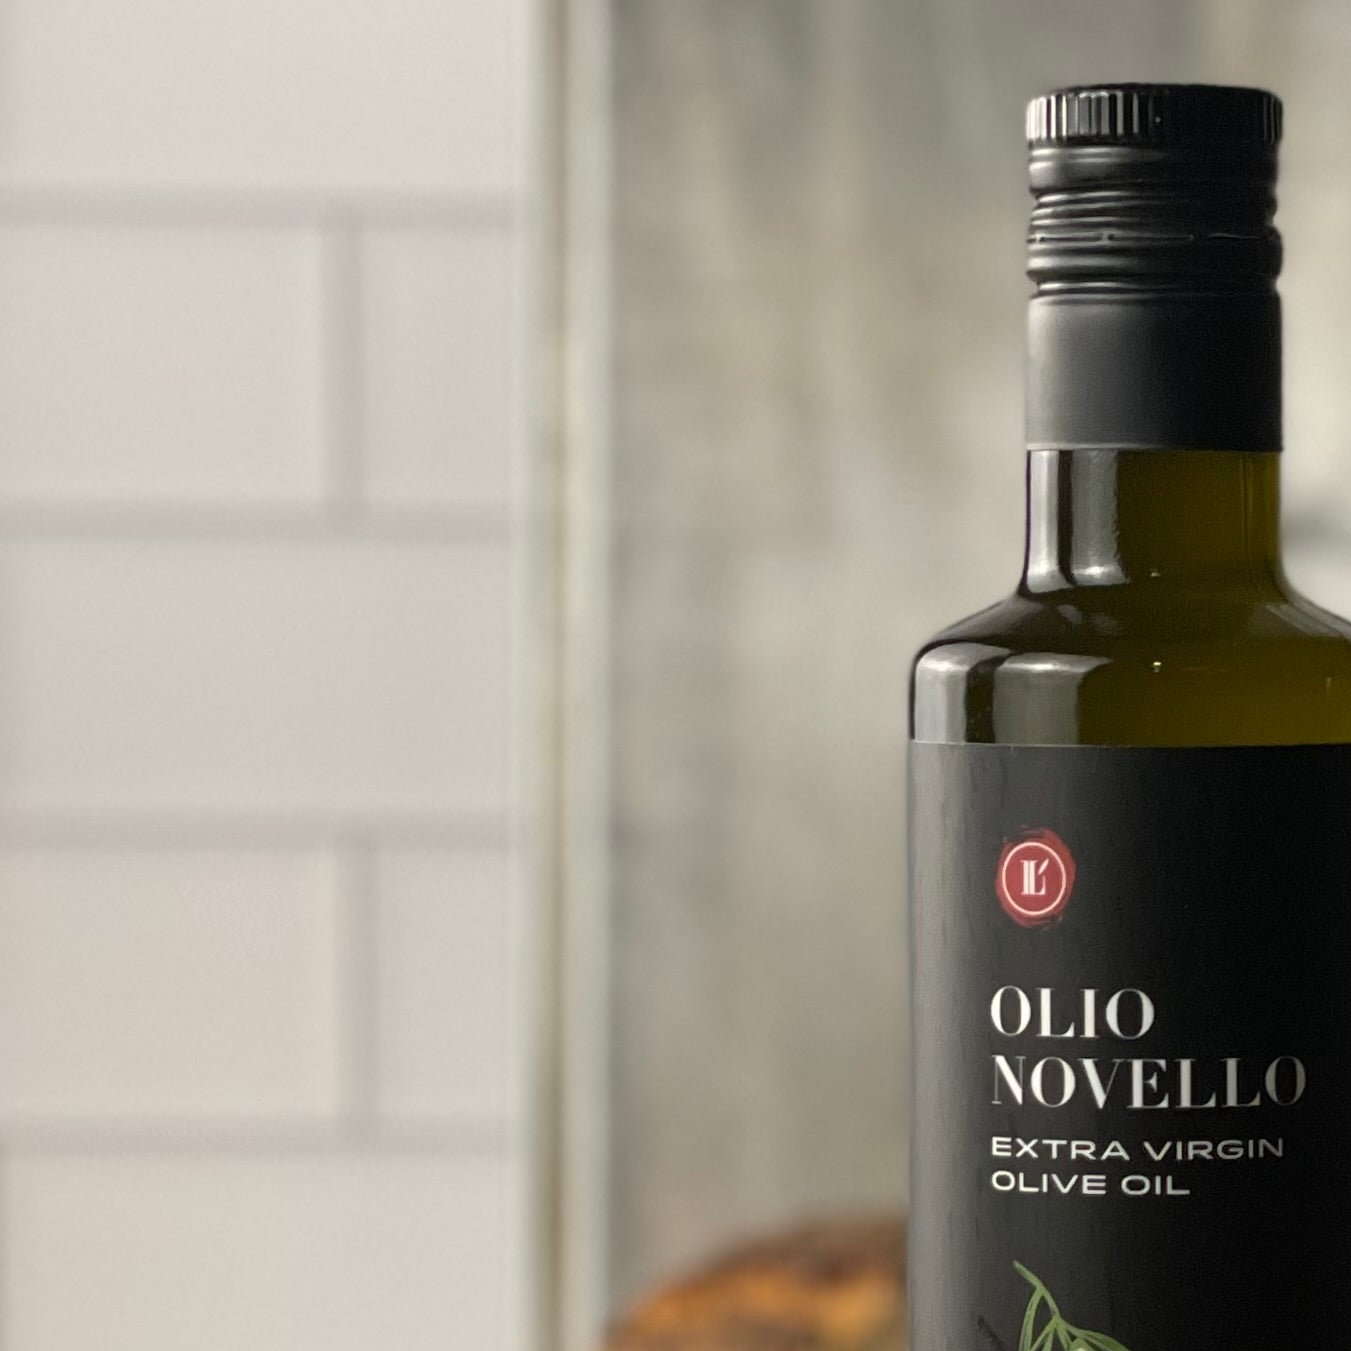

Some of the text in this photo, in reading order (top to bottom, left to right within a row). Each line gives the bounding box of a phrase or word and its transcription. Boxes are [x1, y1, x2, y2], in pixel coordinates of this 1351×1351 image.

[990, 985, 1155, 1040] OLIO
[991, 1055, 1307, 1109] NOVELLO
[991, 1136, 1284, 1161] EXTRA VIRGIN
[991, 1171, 1191, 1196] OLIVE OIL
